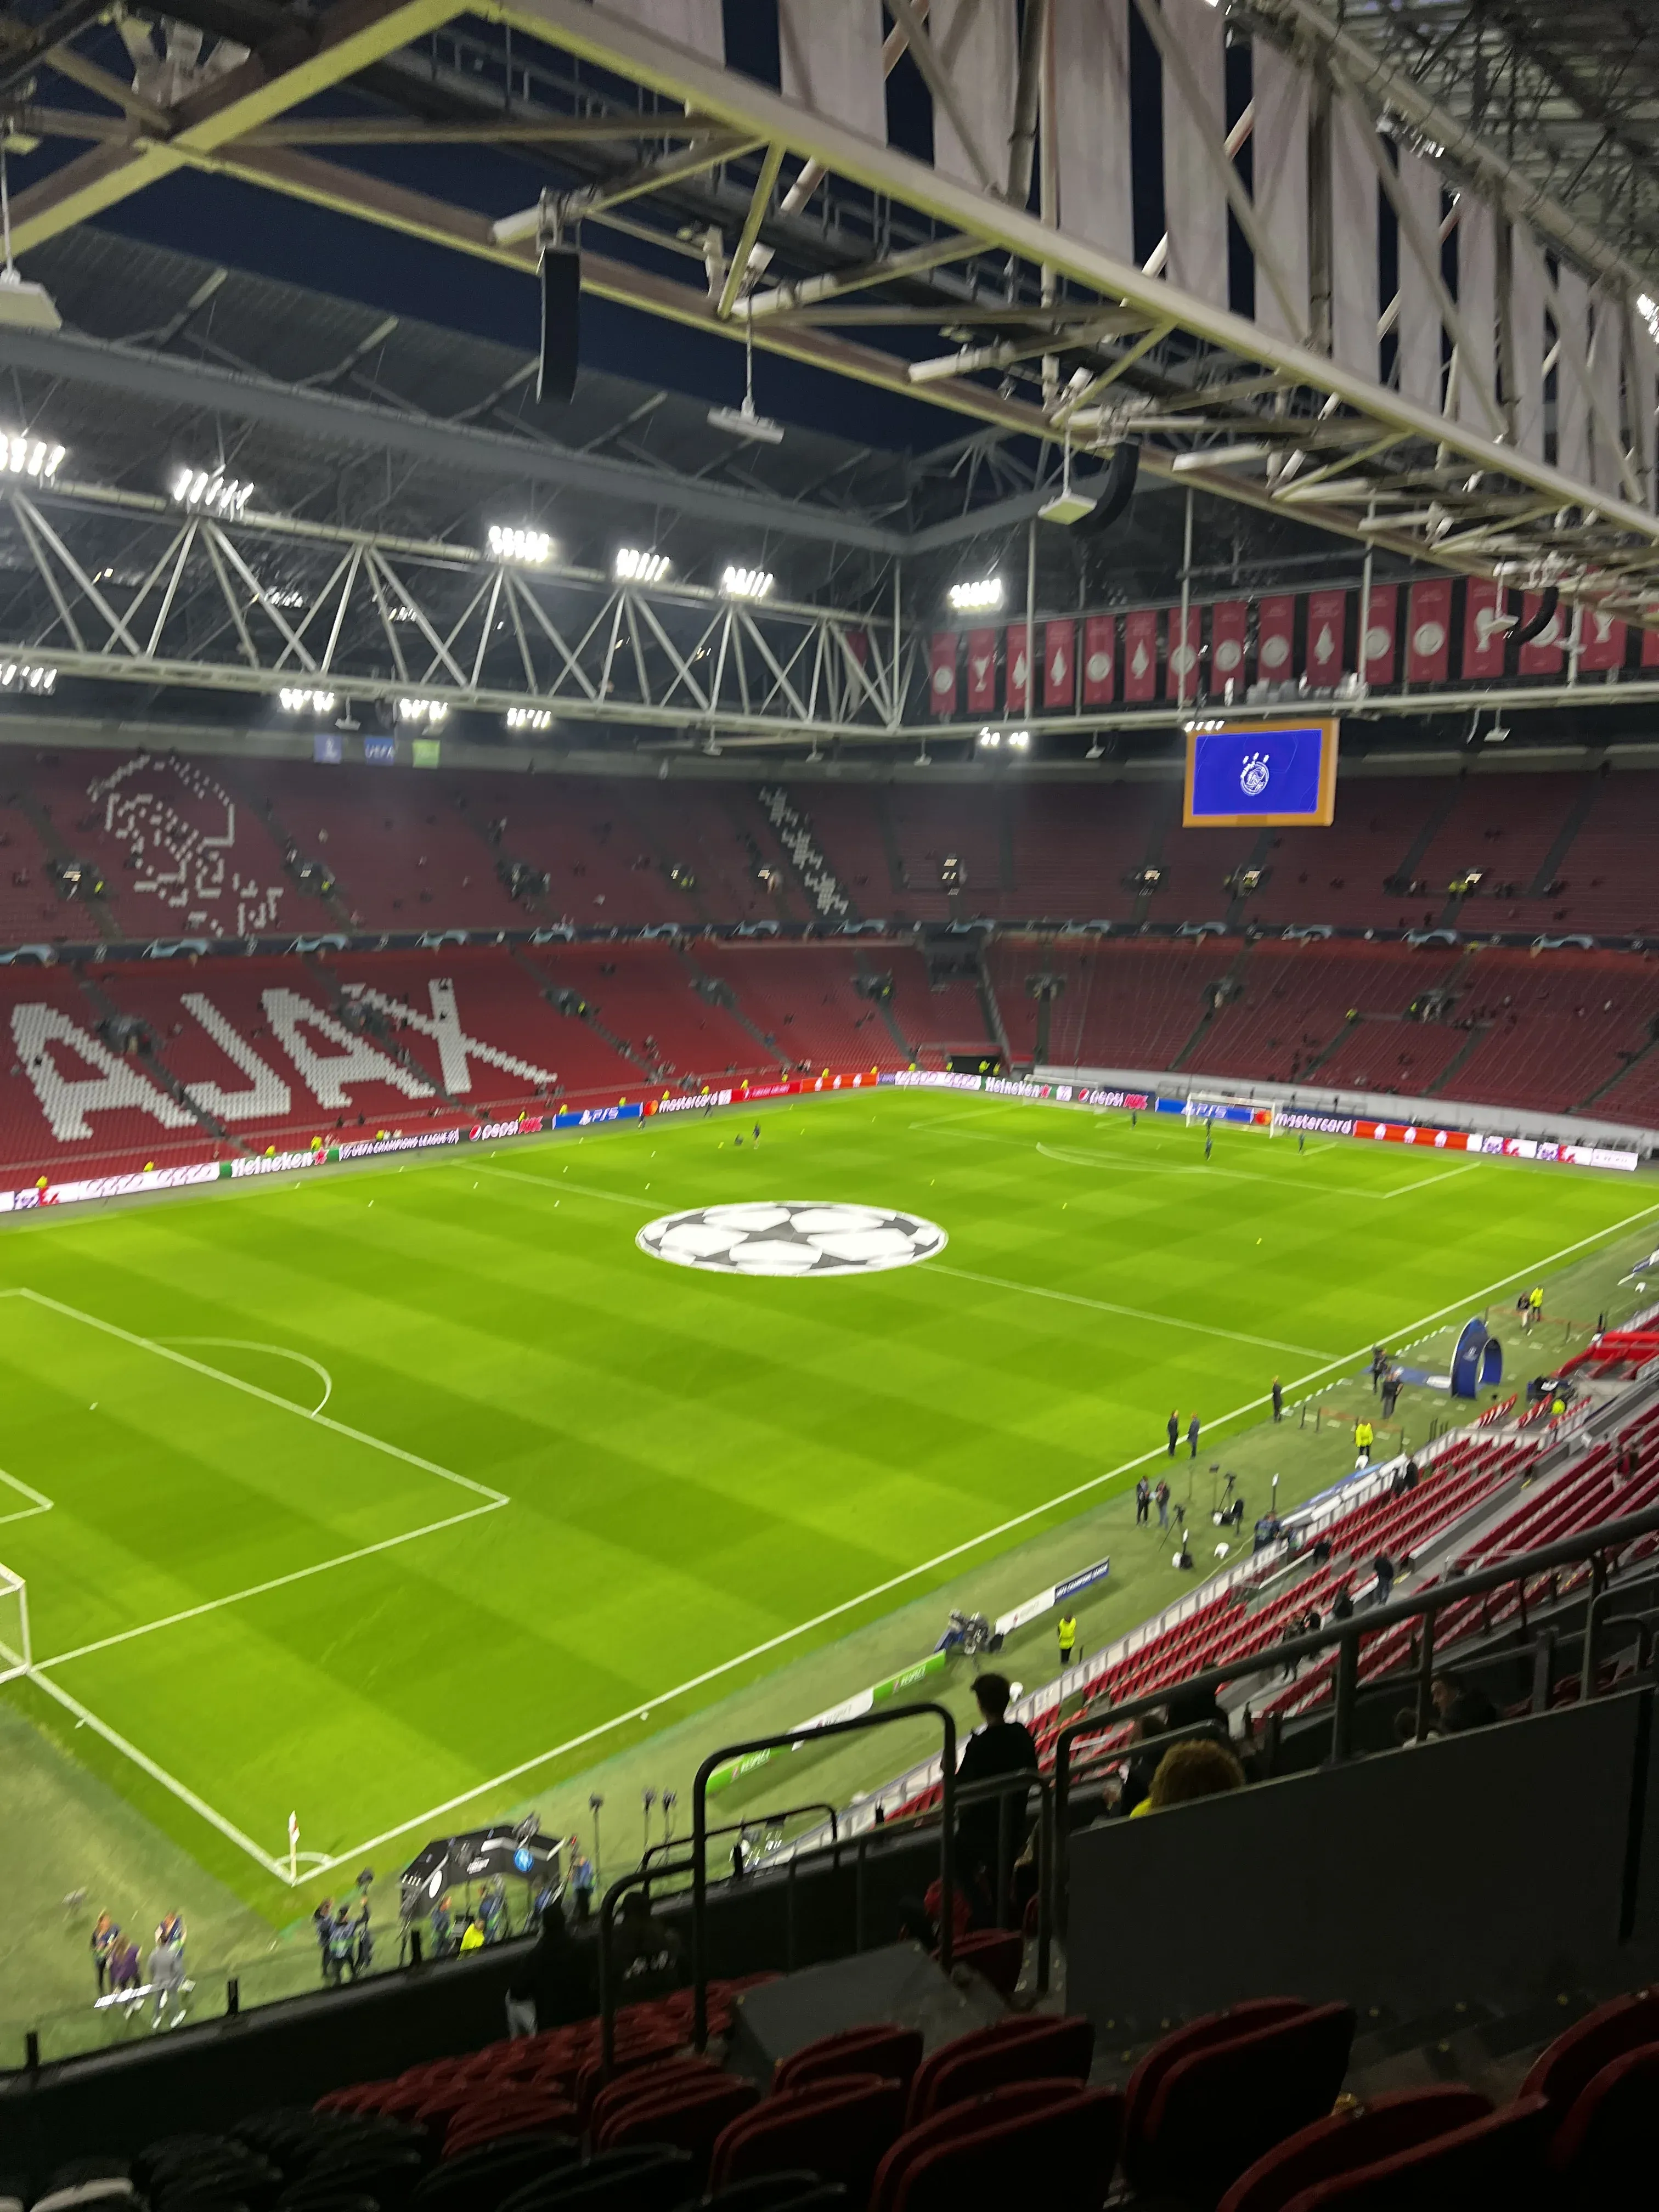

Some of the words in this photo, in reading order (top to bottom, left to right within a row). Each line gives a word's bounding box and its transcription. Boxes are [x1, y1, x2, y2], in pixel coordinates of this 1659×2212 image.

[10, 978, 557, 1143] AJAX
[985, 1076, 1040, 1098] Heineken
[658, 1091, 717, 1113] mastercard
[592, 1107, 619, 1122] PS5
[1274, 1113, 1351, 1134] mastercard
[352, 1143, 373, 1156] UEFA
[374, 1137, 418, 1153] CHAMPIONS
[418, 1132, 448, 1147] LEAGUE
[231, 1152, 313, 1178] Heineken
